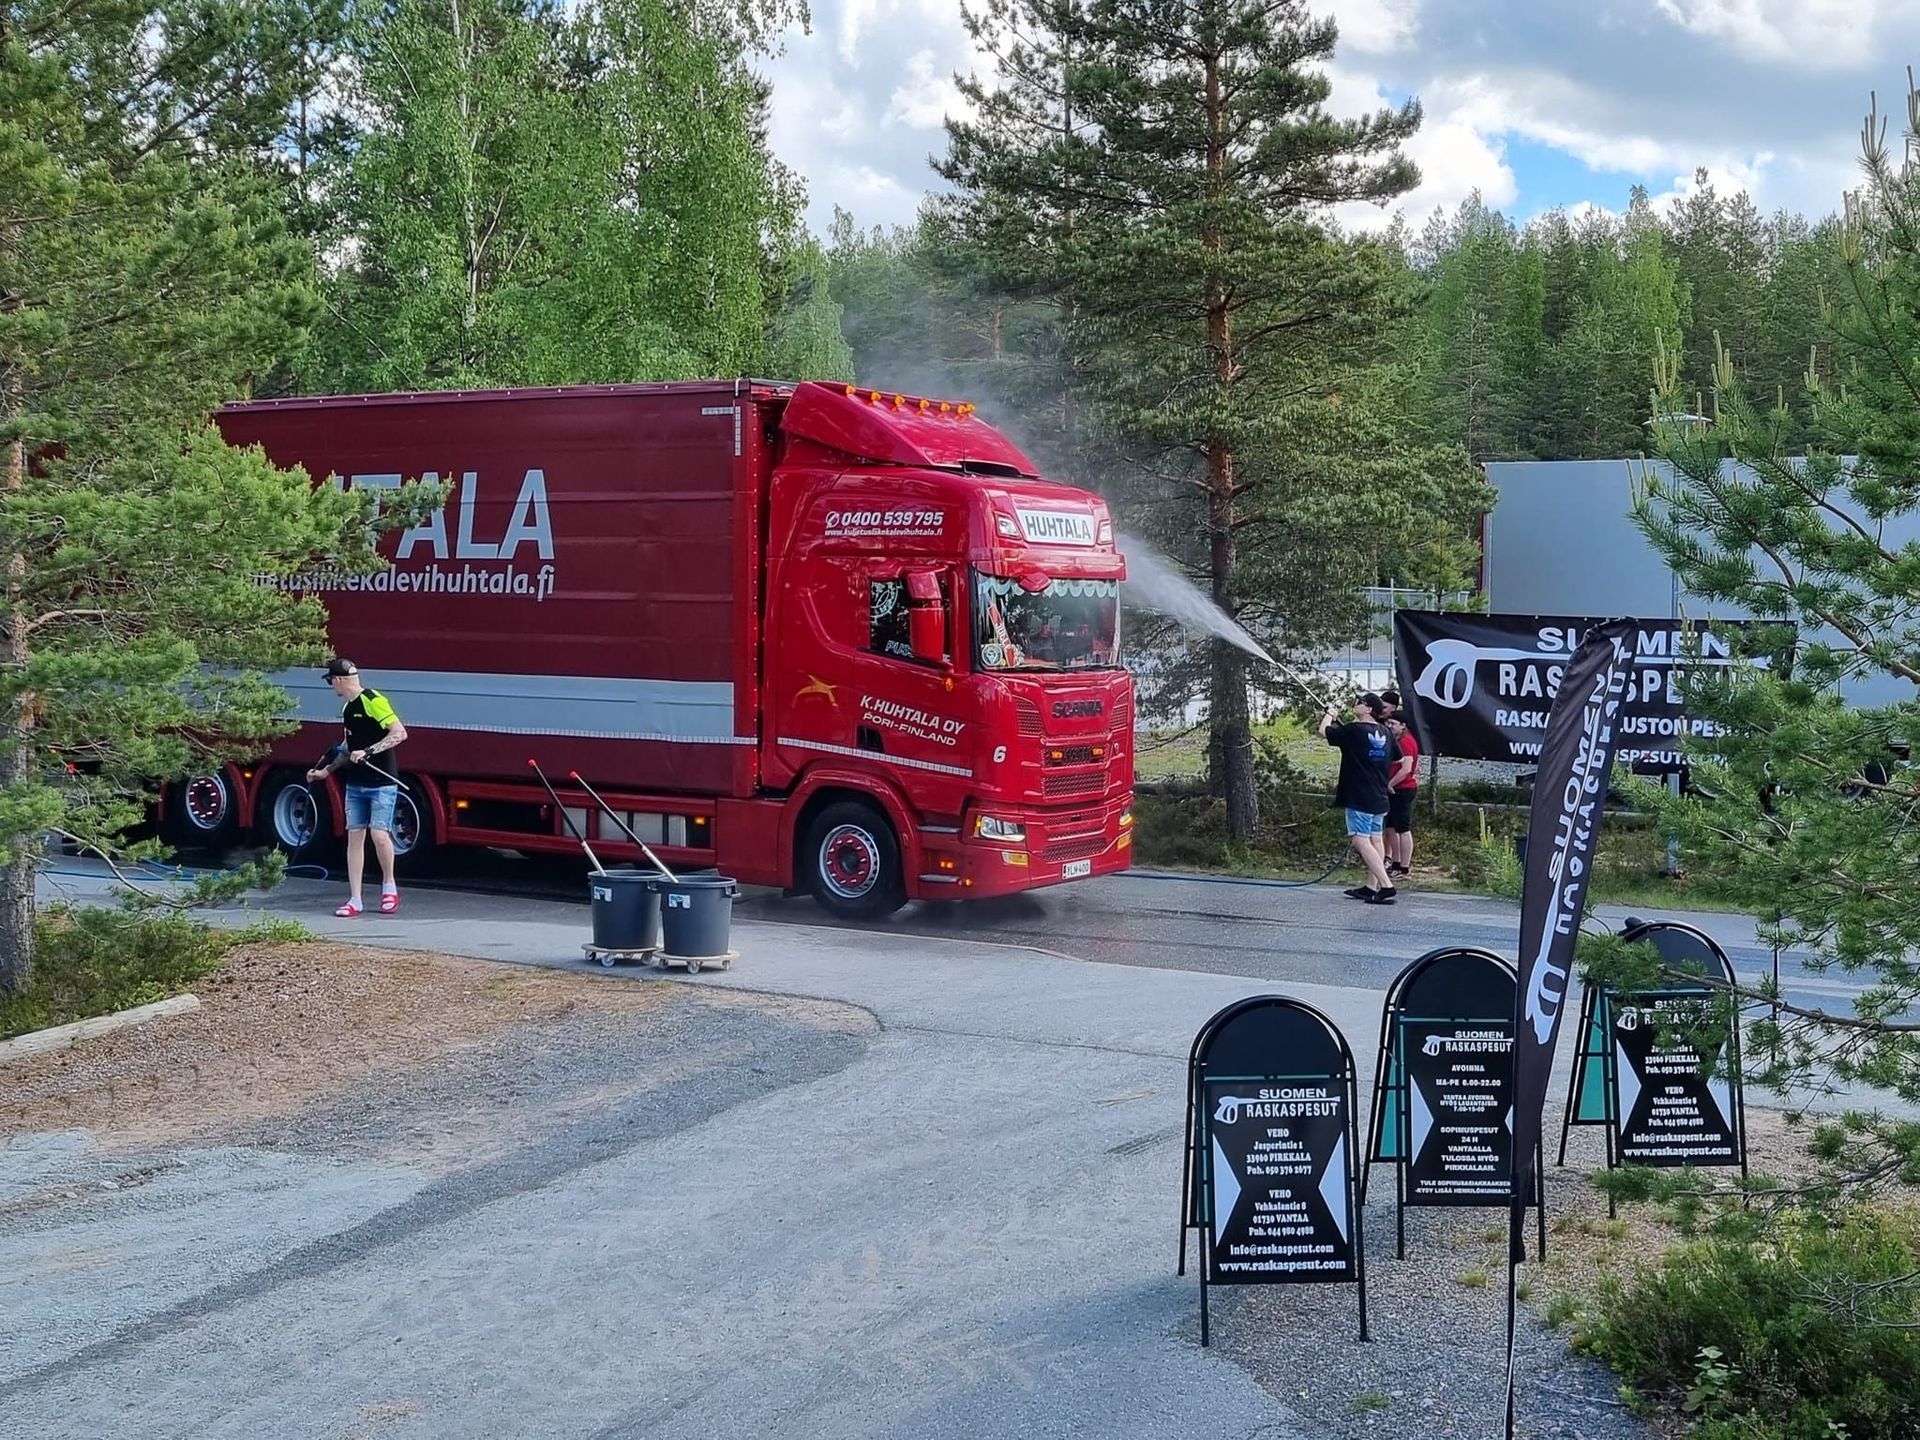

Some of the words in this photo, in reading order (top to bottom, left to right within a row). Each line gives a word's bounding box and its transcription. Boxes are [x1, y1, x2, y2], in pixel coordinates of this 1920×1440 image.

[332, 469, 555, 560] TALA
[841, 511, 882, 526] 0400
[883, 511, 914, 526] 539
[914, 511, 944, 526] 795
[1025, 515, 1092, 540] HUHTALA
[860, 695, 940, 729] K.HUHTALA
[943, 720, 965, 735] OY
[863, 712, 957, 746] PORI-FINLAND
[993, 745, 1007, 763] 6
[1455, 1031, 1503, 1039] SUOMEN
[1446, 1041, 1511, 1052] RASKASPESUT
[1259, 1088, 1327, 1099] SUOMEN
[1247, 1102, 1338, 1117] RASKASPESUT
[1671, 1107, 1699, 1115] VANTAA
[1267, 1129, 1289, 1137] VEHO
[1269, 1152, 1312, 1162] PIRKKALA
[1624, 1147, 1731, 1157] www.raskaspesut.com
[1246, 1166, 1265, 1175] Puh.
[1269, 1190, 1291, 1198] VEHO
[1275, 1213, 1309, 1223] VANTAA
[1248, 1227, 1267, 1236] Puh.
[1219, 1260, 1346, 1272] www.raskaspesut.com
